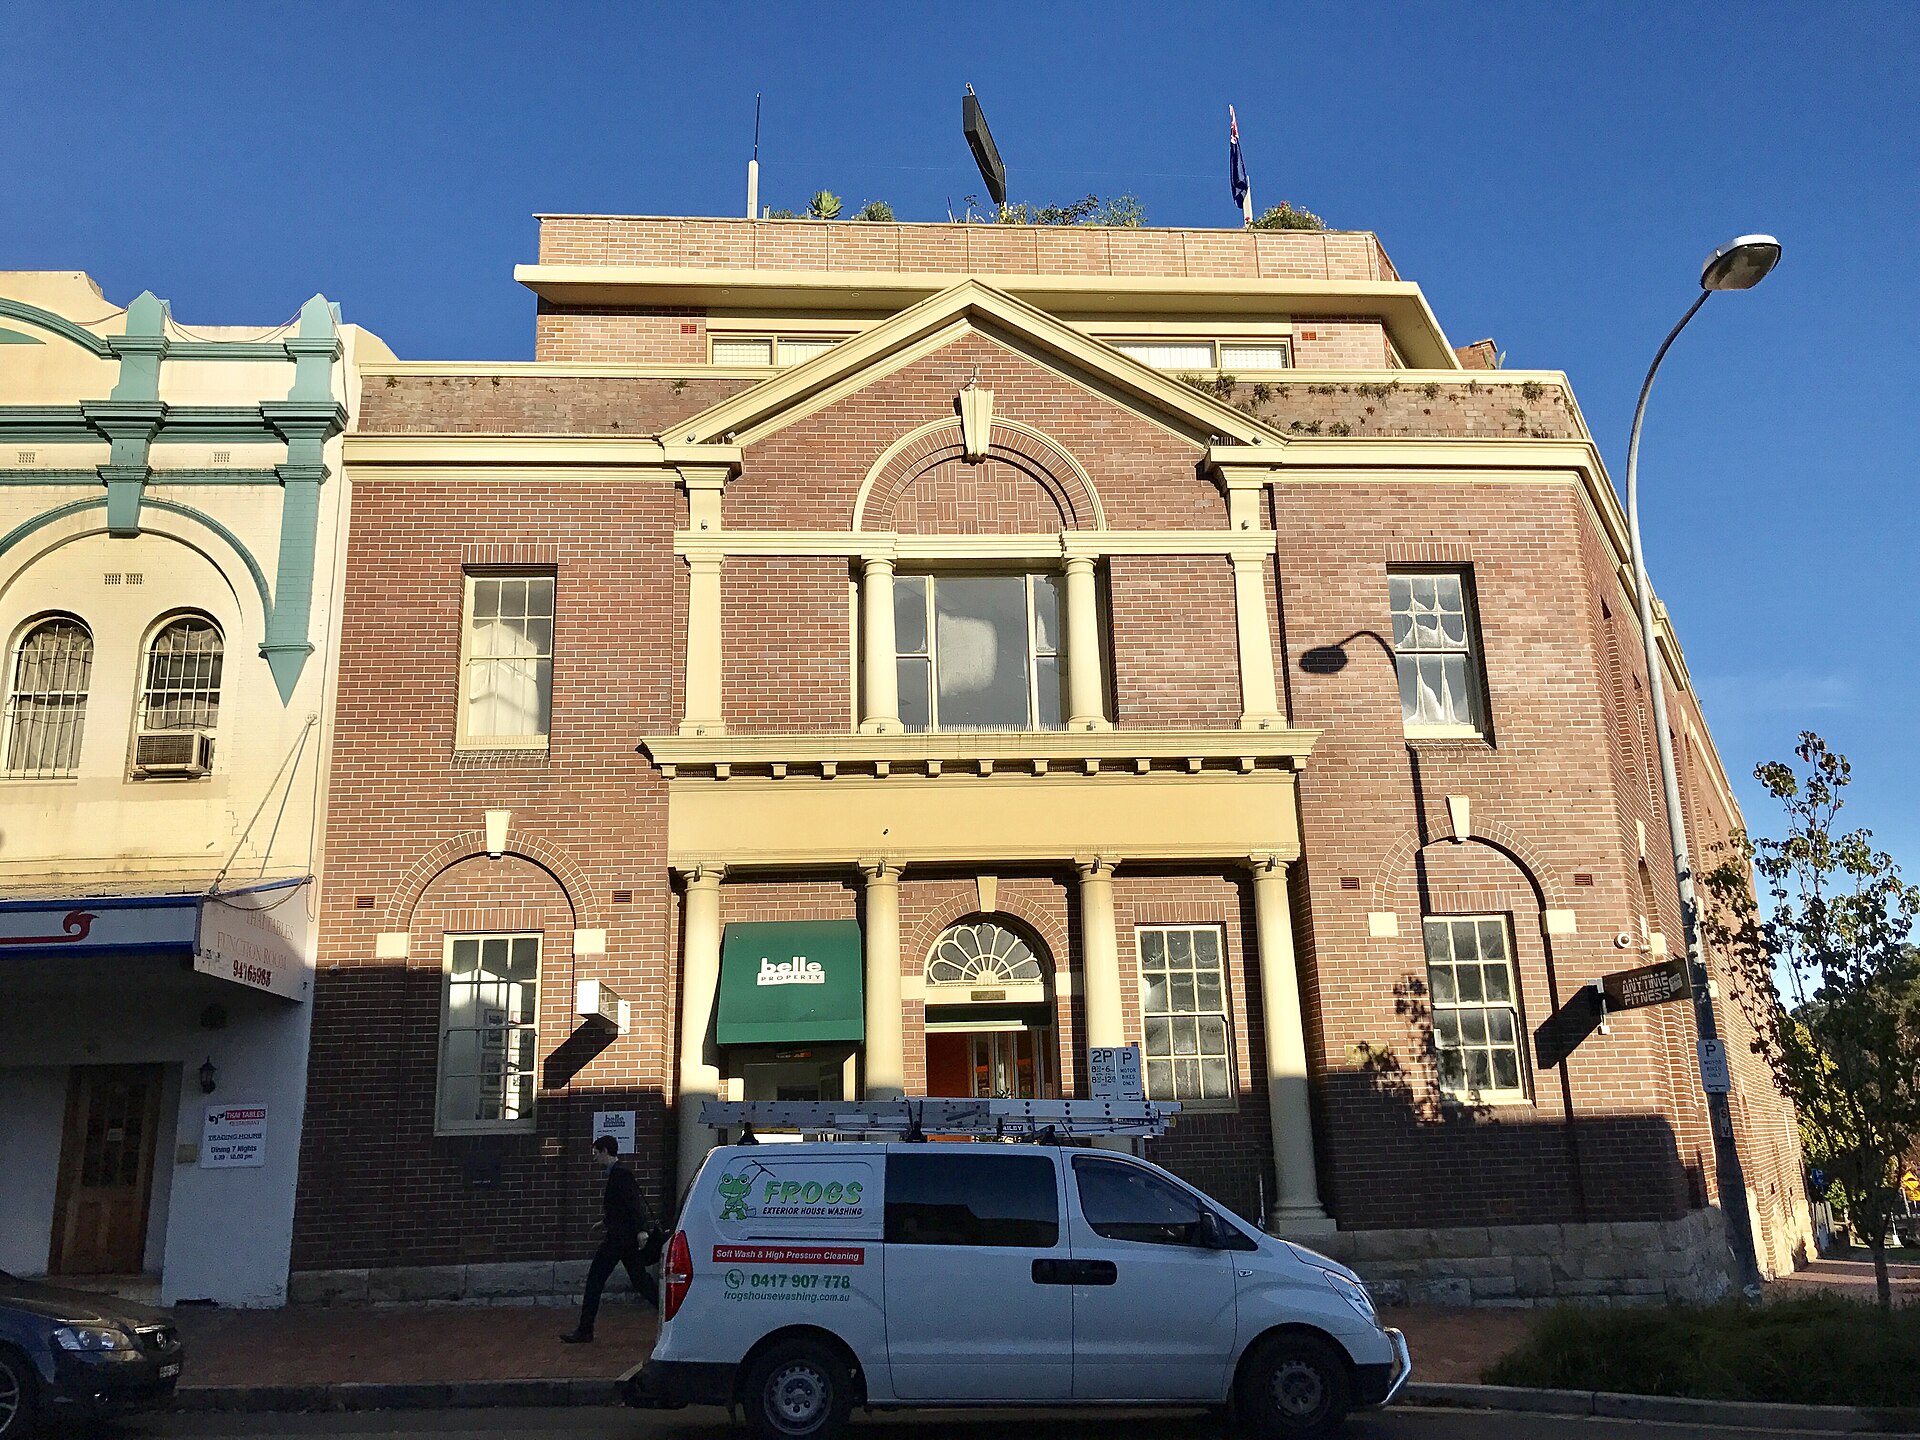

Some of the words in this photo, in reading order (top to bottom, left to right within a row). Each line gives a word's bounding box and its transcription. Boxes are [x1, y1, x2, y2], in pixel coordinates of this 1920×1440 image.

[761, 957, 822, 973] belle
[1622, 971, 1669, 994] ANYTIME
[1624, 986, 1671, 1006] FITNESS
[1092, 1050, 1112, 1063] 2P
[1705, 1044, 1716, 1057] P
[1122, 1052, 1132, 1065] P
[762, 1180, 864, 1206] FROGS
[762, 1206, 800, 1215] EXTERIOR
[800, 1206, 827, 1215] HOUSE
[827, 1207, 863, 1216] WASHING
[716, 1249, 734, 1259] Soft
[734, 1250, 757, 1259] Wash
[757, 1251, 764, 1259] &
[765, 1250, 785, 1260] High
[786, 1251, 822, 1260] Pressure
[823, 1251, 860, 1261] Cleaning
[750, 1273, 787, 1288] 0417
[791, 1274, 821, 1289] 907
[823, 1274, 851, 1290] 778
[723, 1290, 851, 1304] frogshousewashing.com.au
